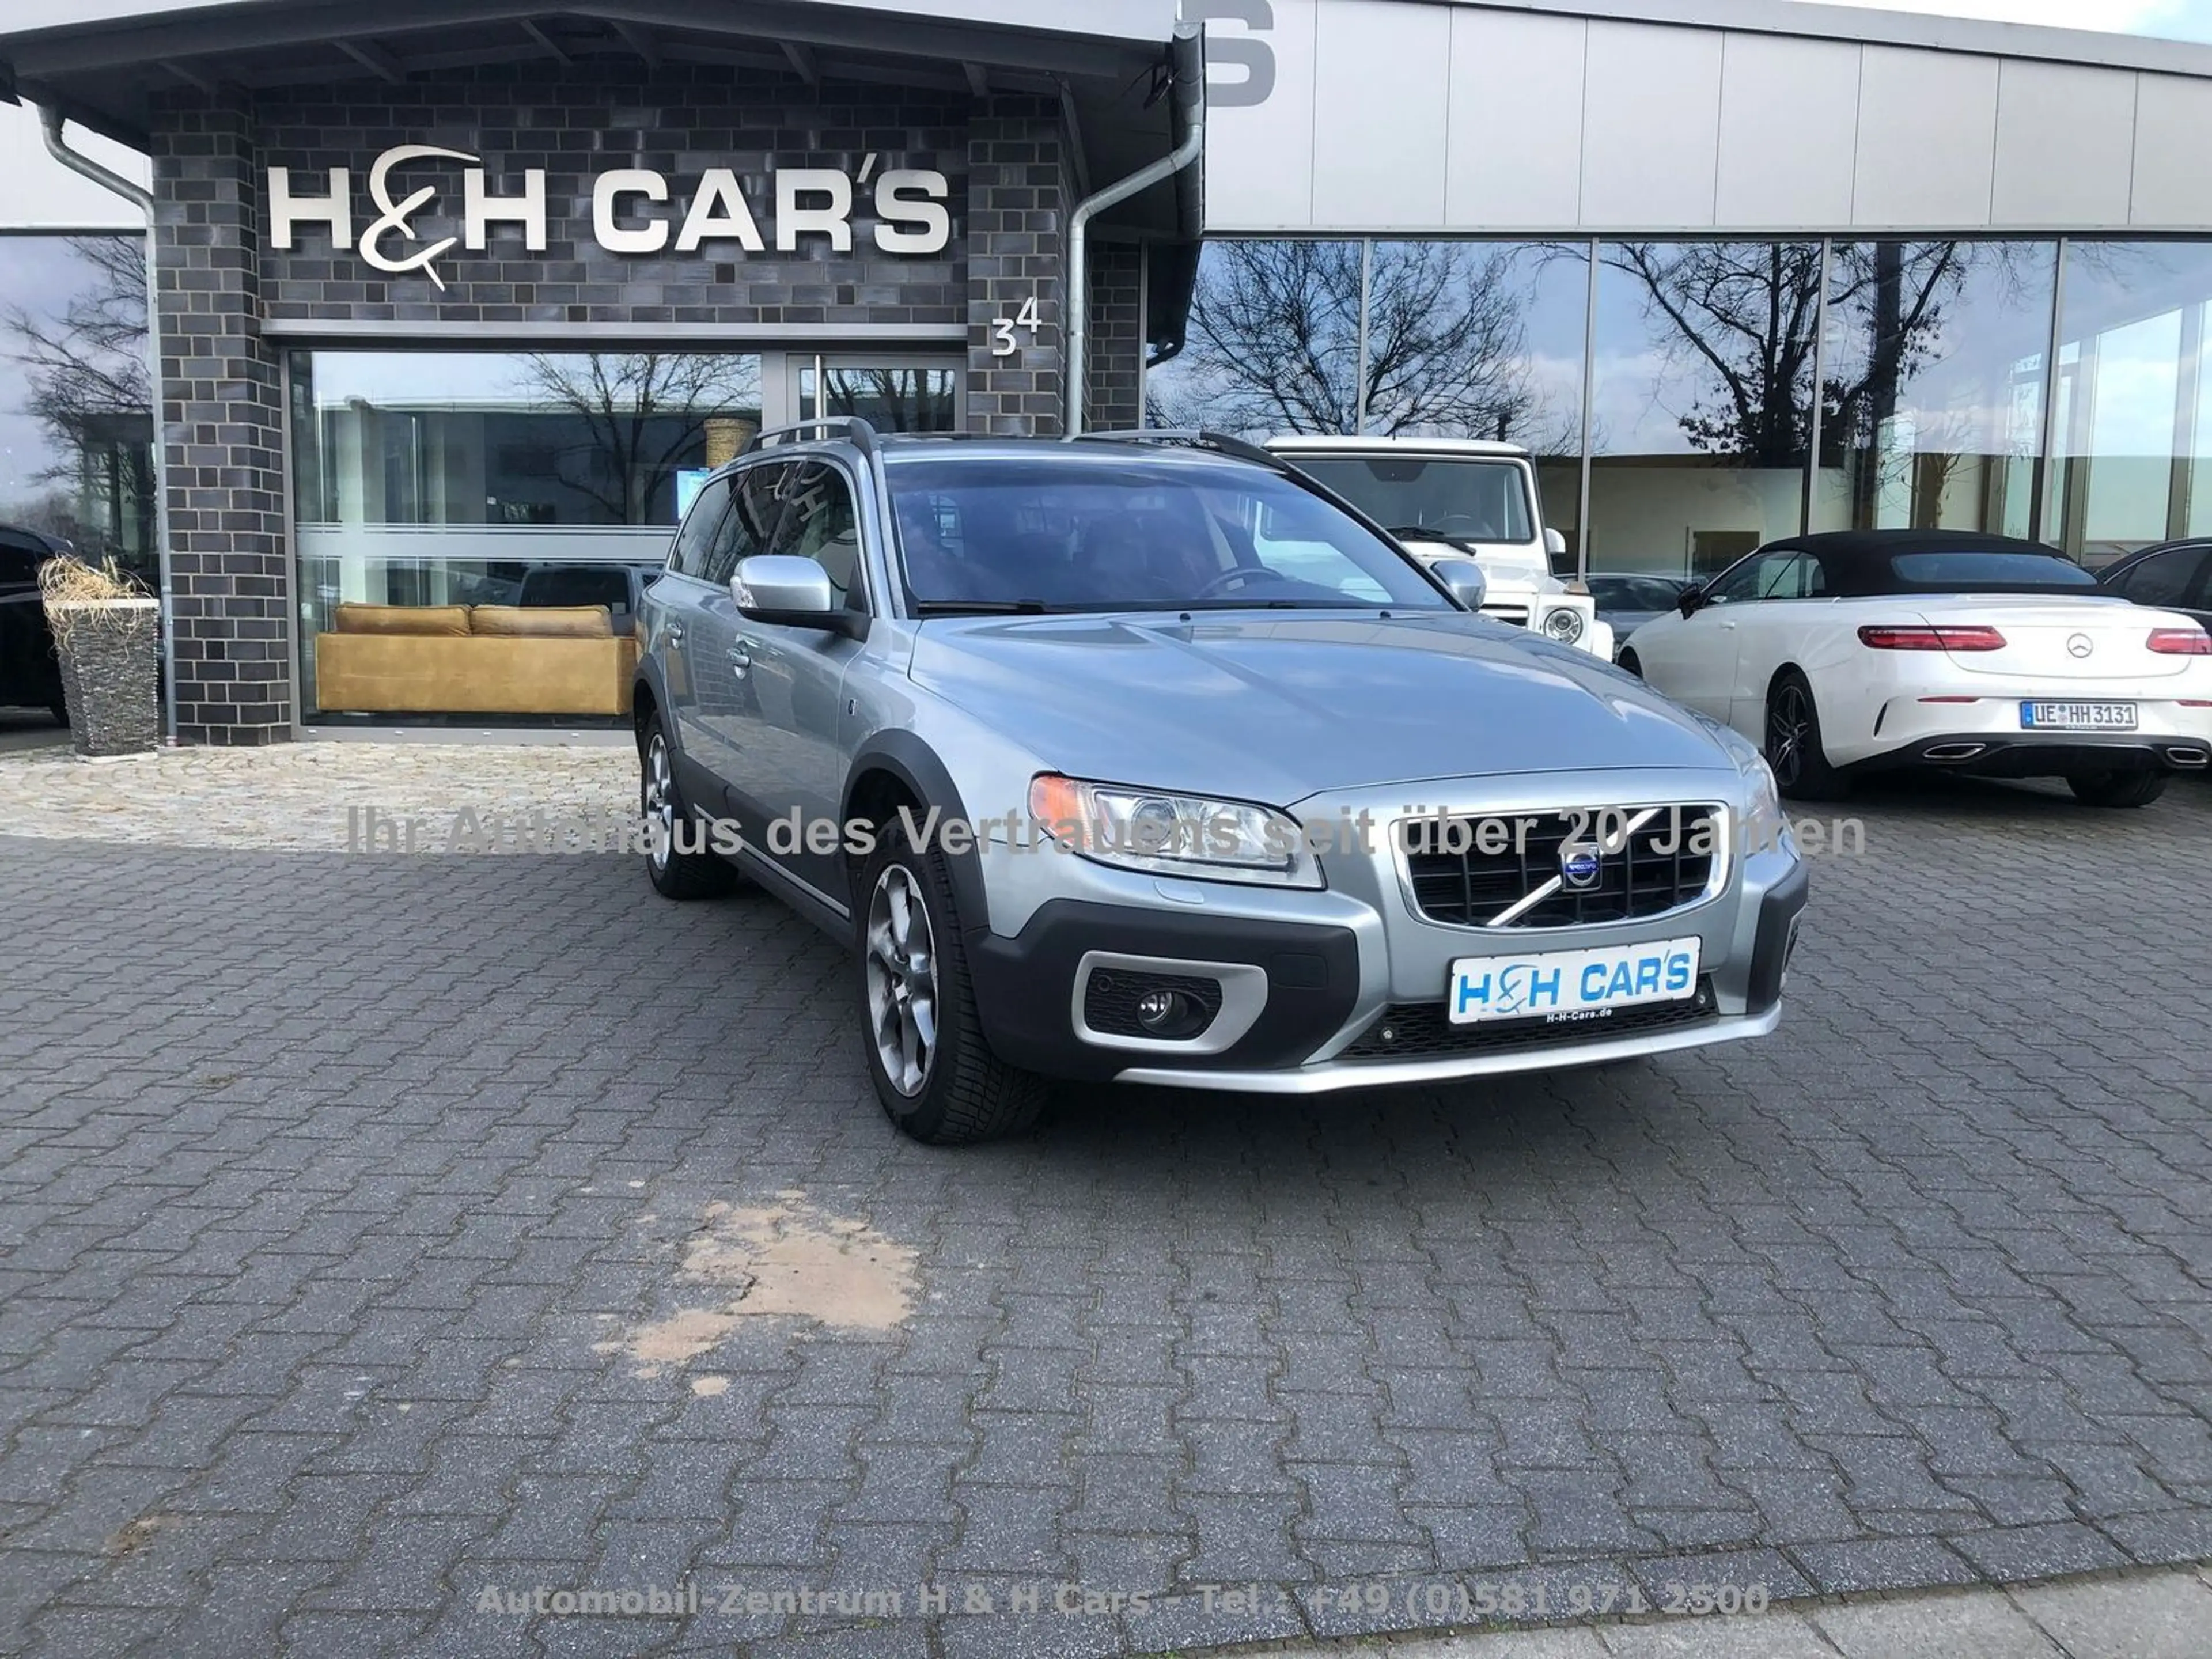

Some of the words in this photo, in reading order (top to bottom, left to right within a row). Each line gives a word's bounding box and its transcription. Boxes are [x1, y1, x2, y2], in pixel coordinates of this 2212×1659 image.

[592, 153, 949, 252] CAR'S
[992, 296, 1042, 356] 34
[2036, 705, 2056, 723] UE
[1580, 949, 1690, 1002] CAR'S
[1546, 1007, 1612, 1023] H-H-Cars.de
